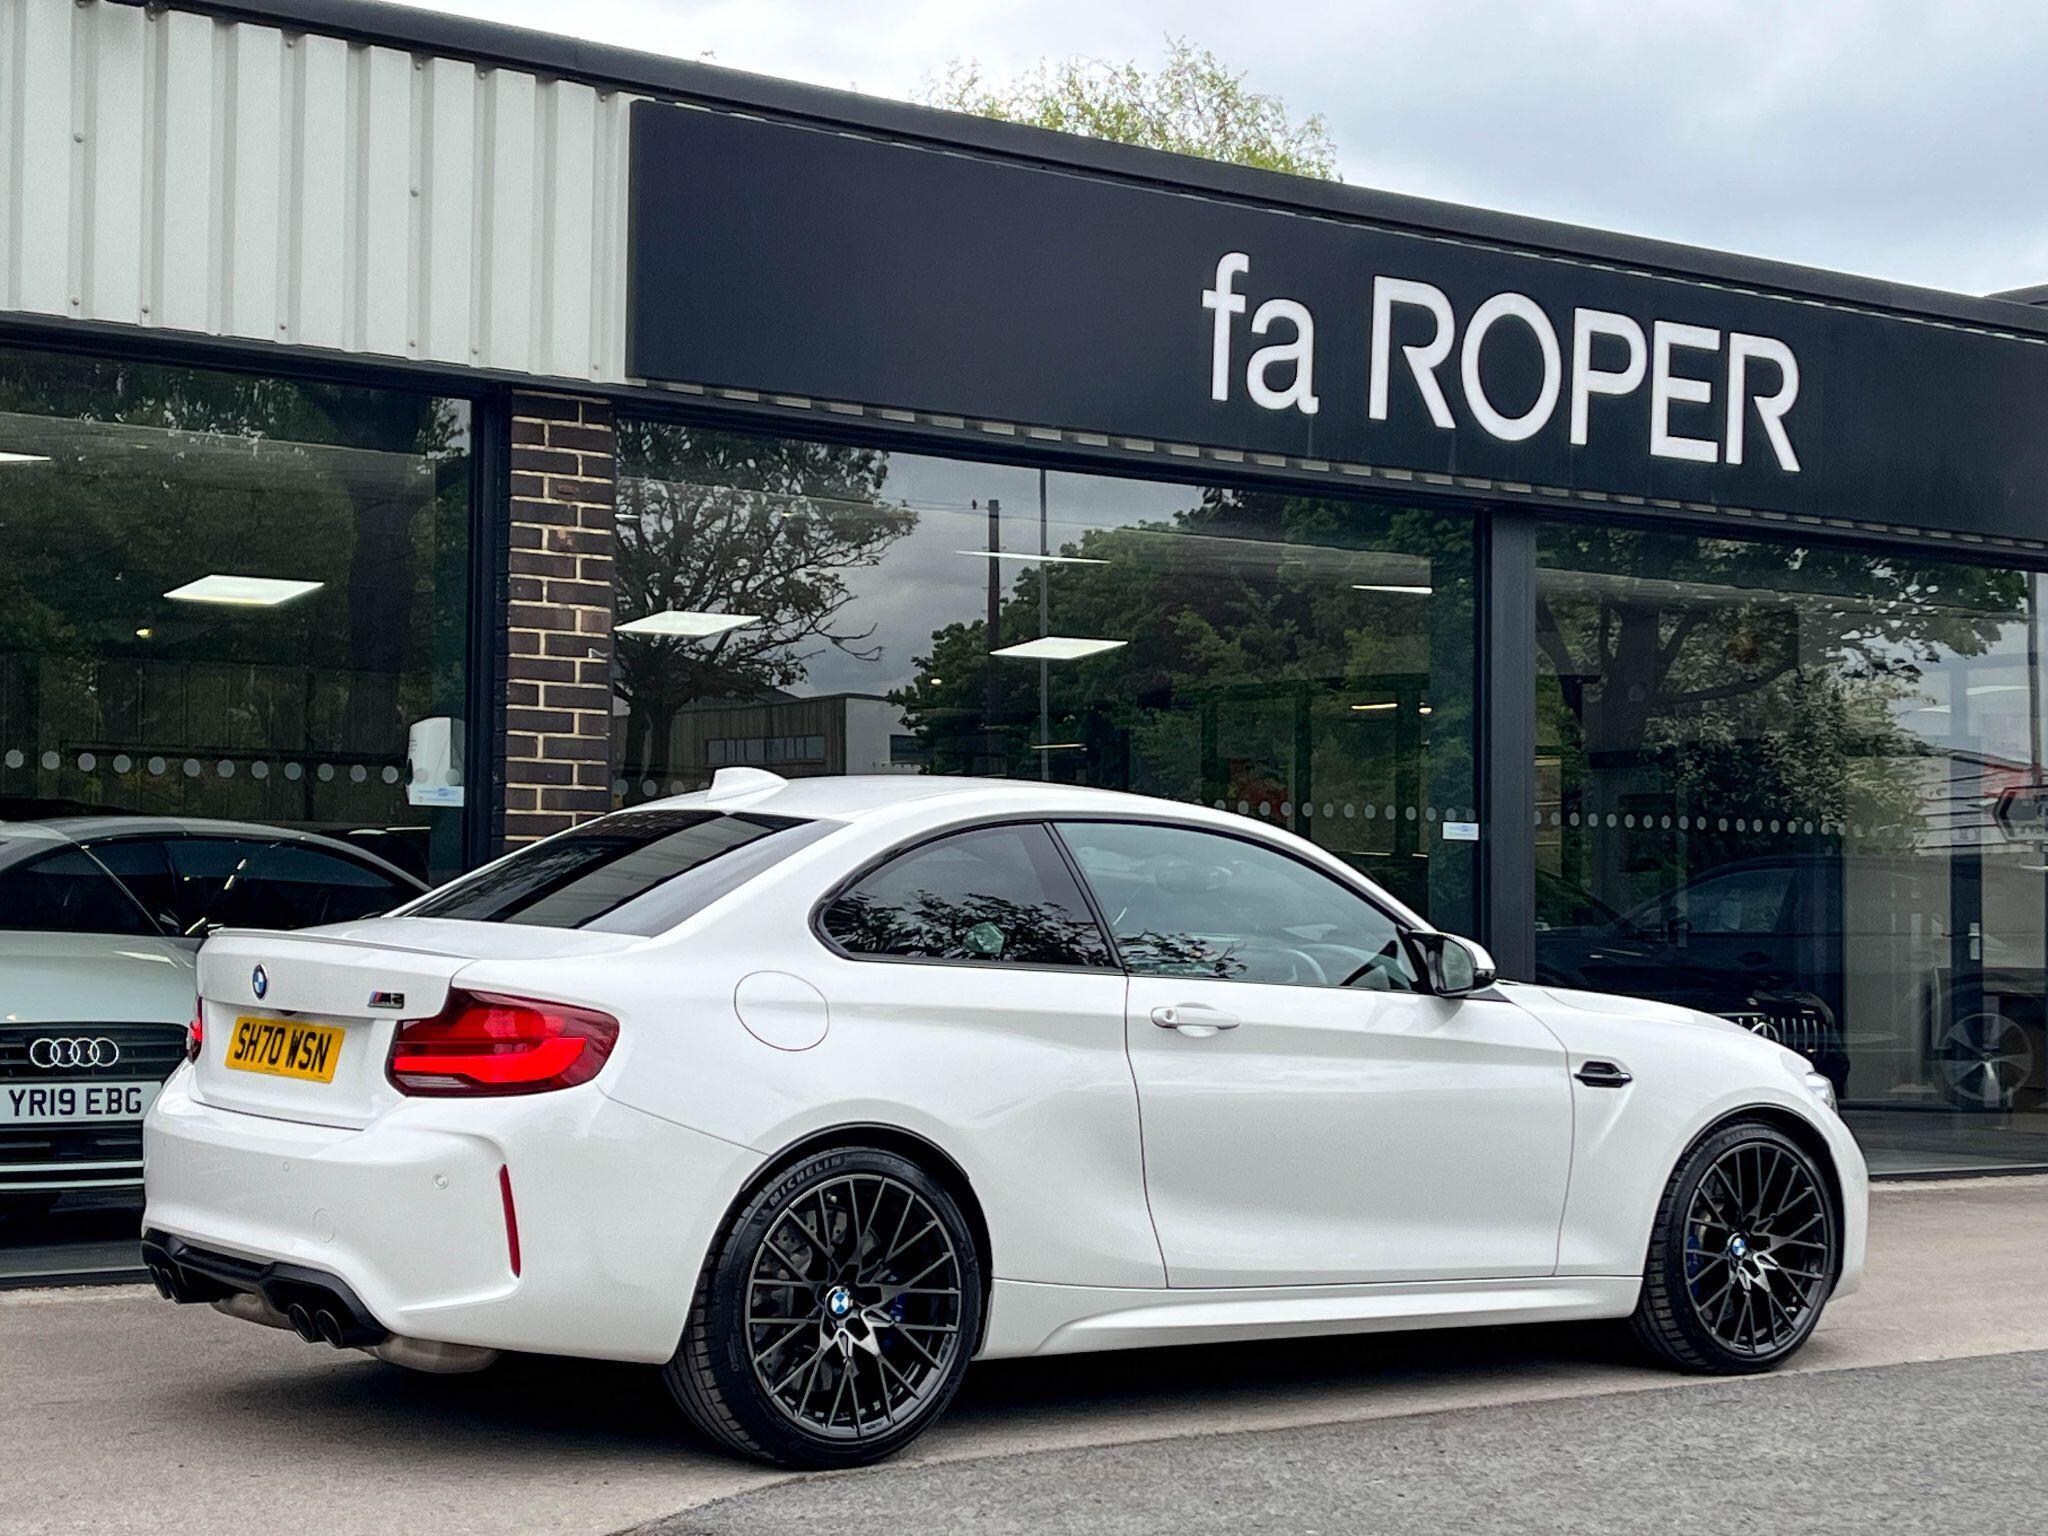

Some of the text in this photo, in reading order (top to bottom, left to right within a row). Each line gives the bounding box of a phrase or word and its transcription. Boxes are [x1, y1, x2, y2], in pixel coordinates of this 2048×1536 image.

[1202, 252, 1801, 473] fa ROPER
[234, 1022, 332, 1073] SH70 WSN
[8, 1087, 142, 1117] YR19 EBG
[769, 1156, 842, 1207] MICHELIN
